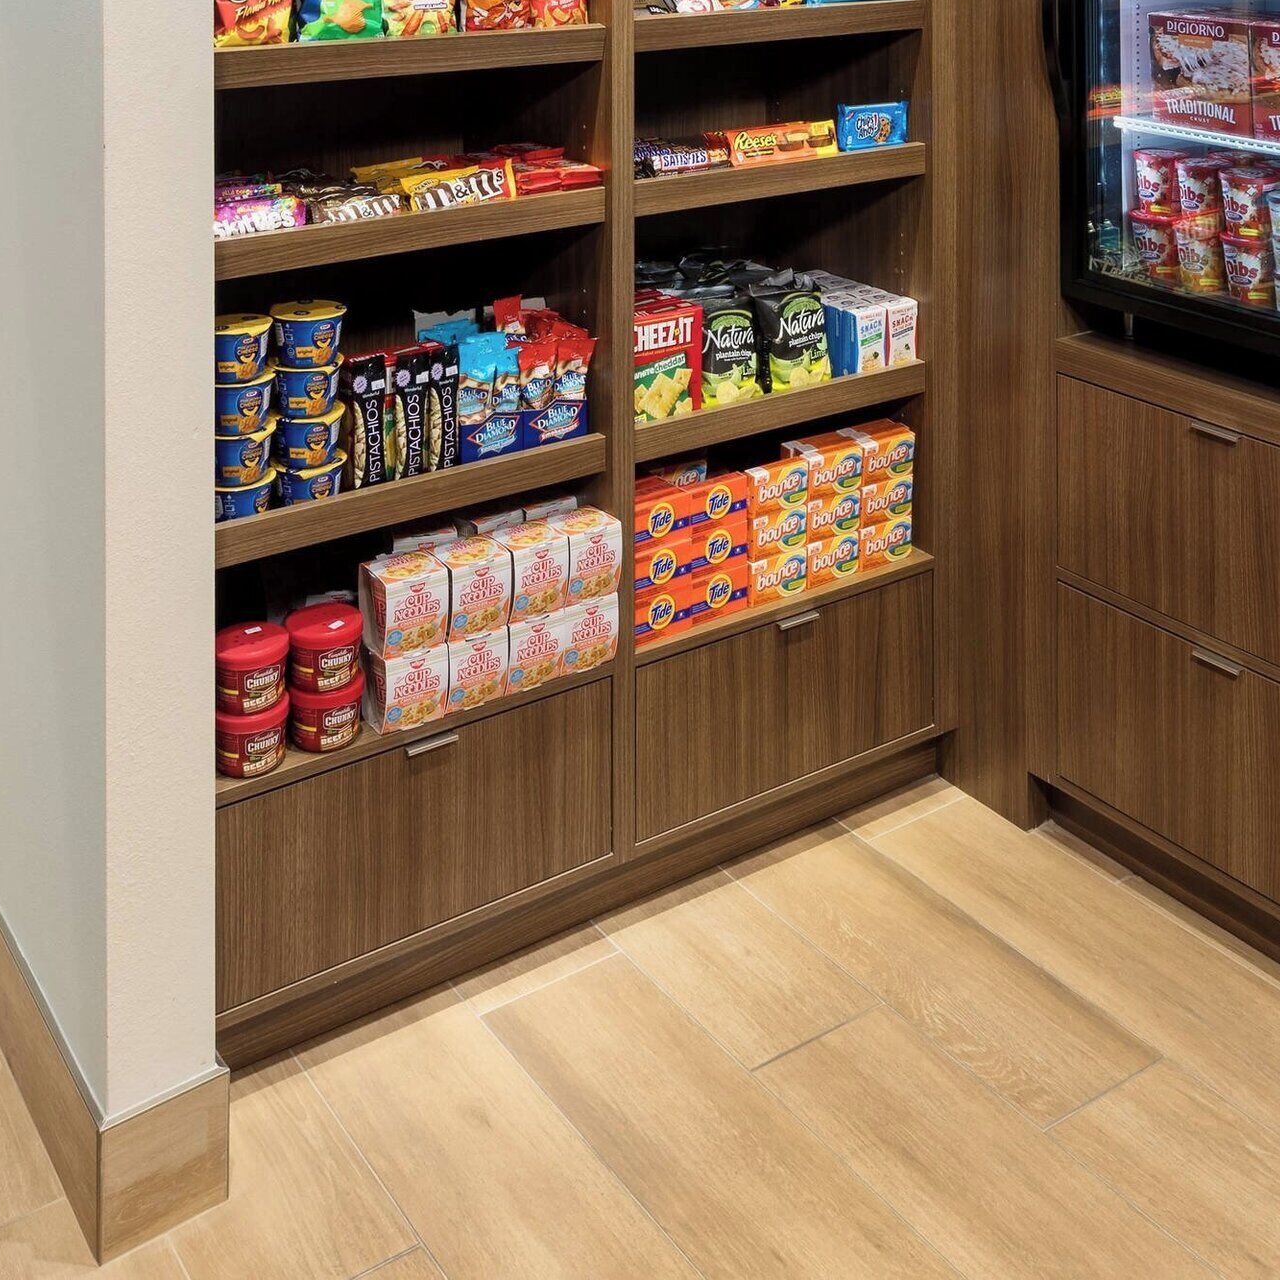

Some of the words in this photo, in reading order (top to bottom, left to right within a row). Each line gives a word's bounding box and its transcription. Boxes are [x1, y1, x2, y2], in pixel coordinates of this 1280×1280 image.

[1167, 20, 1224, 38] DIGIORNO
[1165, 99, 1237, 125] TRADITIONAL
[734, 131, 778, 152] Reese's
[1135, 236, 1166, 254] Dibs
[1225, 259, 1259, 278] Dibs
[861, 320, 882, 335] SNACK
[892, 314, 913, 329] SNACK
[788, 336, 808, 347] plantain
[655, 353, 686, 374] cheddar
[715, 350, 740, 361] plantain
[538, 406, 578, 430] DIAMOND
[548, 404, 569, 419] BLUE
[442, 386, 455, 468] PISTACHIOS
[475, 419, 516, 443] DIAMOND
[486, 417, 507, 432] BLUE
[366, 399, 381, 483] PISTACHIOS
[407, 394, 421, 476] PISTACHIOS
[868, 445, 908, 472] bounce
[813, 460, 855, 488] bounce
[758, 474, 801, 503] bounce
[709, 493, 730, 511] Tide
[866, 487, 906, 515] bounce
[651, 510, 672, 529] Tide
[812, 501, 853, 530] bounce
[757, 517, 800, 548] bounce
[865, 528, 905, 556] bounce
[586, 543, 609, 559] CUP
[709, 537, 730, 556] Tide
[531, 558, 554, 574] CUP
[577, 549, 616, 573] NOODLES
[652, 556, 674, 575] Tide
[812, 543, 853, 572] bounce
[471, 576, 496, 591] CUP
[521, 564, 563, 588] NOODLES
[756, 561, 799, 592] bounce
[405, 591, 432, 608] CUP
[459, 583, 504, 607] NOODLES
[709, 583, 730, 602] Tide
[394, 599, 441, 623] NOODLES
[651, 602, 673, 621] Tide
[581, 614, 605, 630] CUP
[527, 631, 551, 648] CUP
[571, 620, 612, 644] NOODLES
[468, 650, 493, 665] CUP
[517, 638, 559, 662] NOODLES
[321, 653, 353, 669] CHUNKY
[457, 657, 501, 682] NOODLES
[247, 673, 279, 689] CHUNKY
[405, 668, 431, 685] CUP
[394, 676, 441, 700] NOODLES
[325, 711, 357, 727] CHUNKY
[247, 735, 280, 752] CHUNKY
